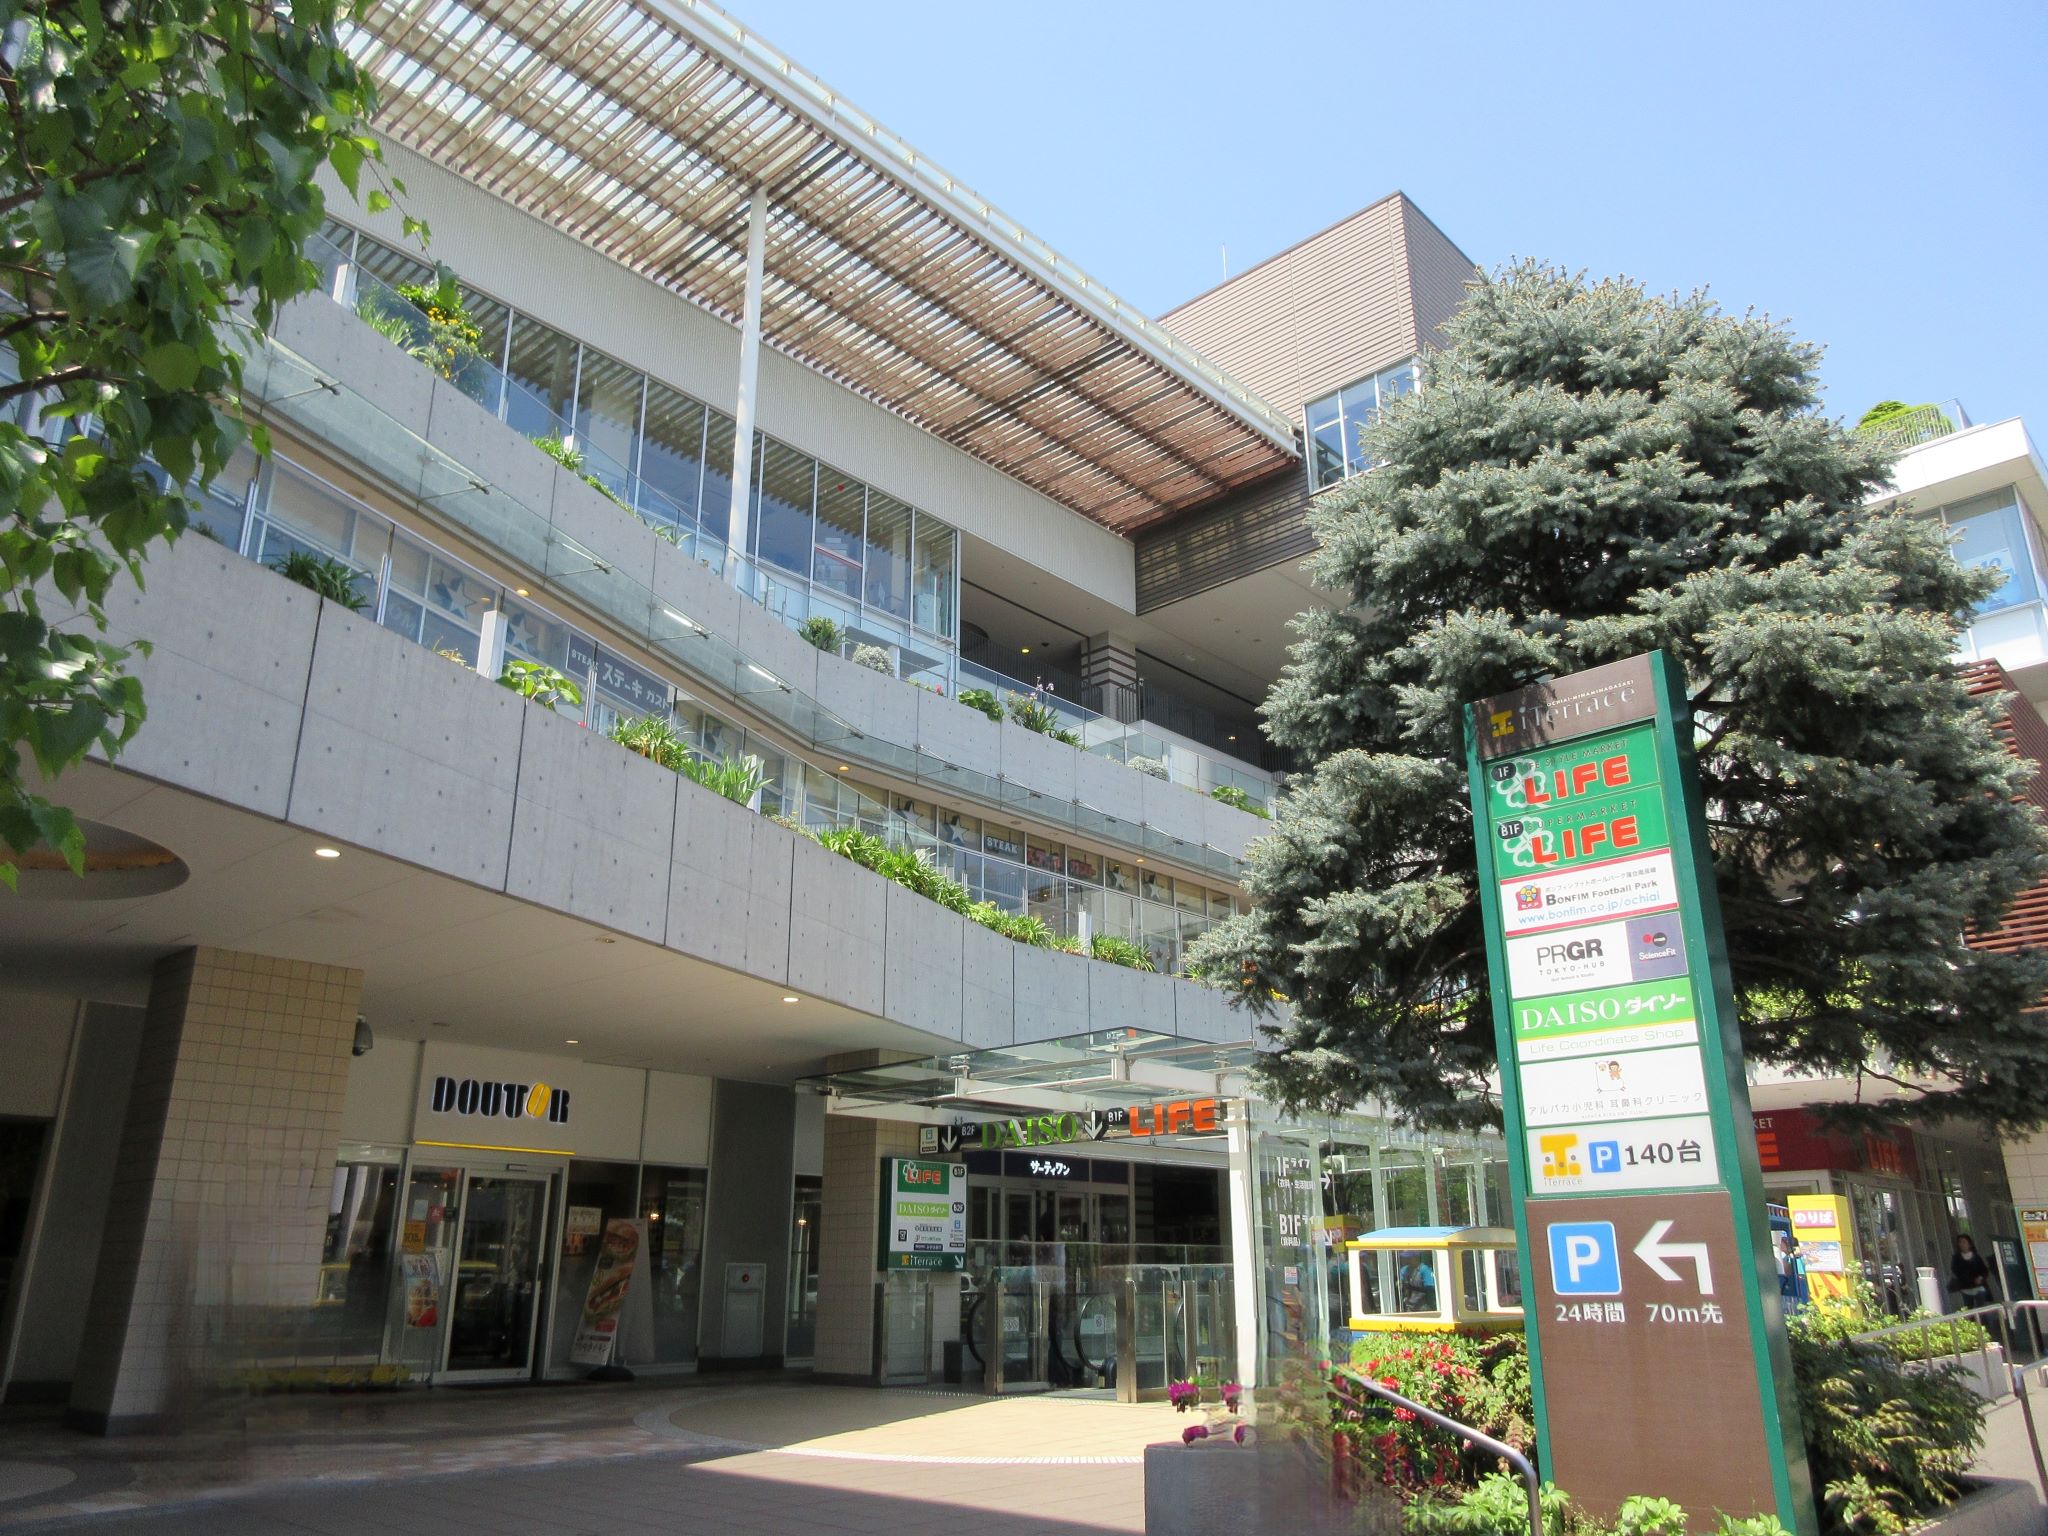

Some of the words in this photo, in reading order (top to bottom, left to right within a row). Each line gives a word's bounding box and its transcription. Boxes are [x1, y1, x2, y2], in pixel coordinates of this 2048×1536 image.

[602, 662, 643, 698] ステーキ
[646, 690, 670, 709] ガスト
[1582, 739, 1628, 757] MARKET
[1498, 766, 1510, 778] 1F
[1523, 753, 1631, 805] LIFE
[1501, 823, 1520, 837] B1F
[1531, 815, 1640, 865] LIFE
[986, 836, 1018, 855] STEAK
[1592, 885, 1632, 898] Football
[1634, 879, 1658, 891] Park
[1518, 891, 1660, 924] www.bonfim.co.jp/ochiai
[1536, 938, 1603, 966] PRGR
[1520, 998, 1620, 1031] DAISO
[1624, 992, 1686, 1016] ダイソー
[1530, 1040, 1555, 1054] Life
[1559, 1031, 1640, 1050] Coordinate
[1644, 1028, 1684, 1043] Shop
[432, 1076, 570, 1123] DOUTOR
[1108, 1109, 1124, 1123] B1F
[1128, 1098, 1217, 1137] LIFE
[961, 1125, 976, 1136] B2F
[981, 1111, 1077, 1151] DAISO
[1625, 1139, 1701, 1165] 140台
[906, 1168, 942, 1185] LIFE
[1029, 1160, 1070, 1177] サーティワン
[1276, 1156, 1290, 1177] 1F
[898, 1204, 931, 1214] DAISO
[1794, 1210, 1834, 1225] のりば
[1280, 1213, 1301, 1236] B1F
[910, 1255, 942, 1266] iTerrace
[1565, 1234, 1600, 1283] P
[1555, 1303, 1625, 1323] 24時間
[1646, 1302, 1723, 1324] 70m先
